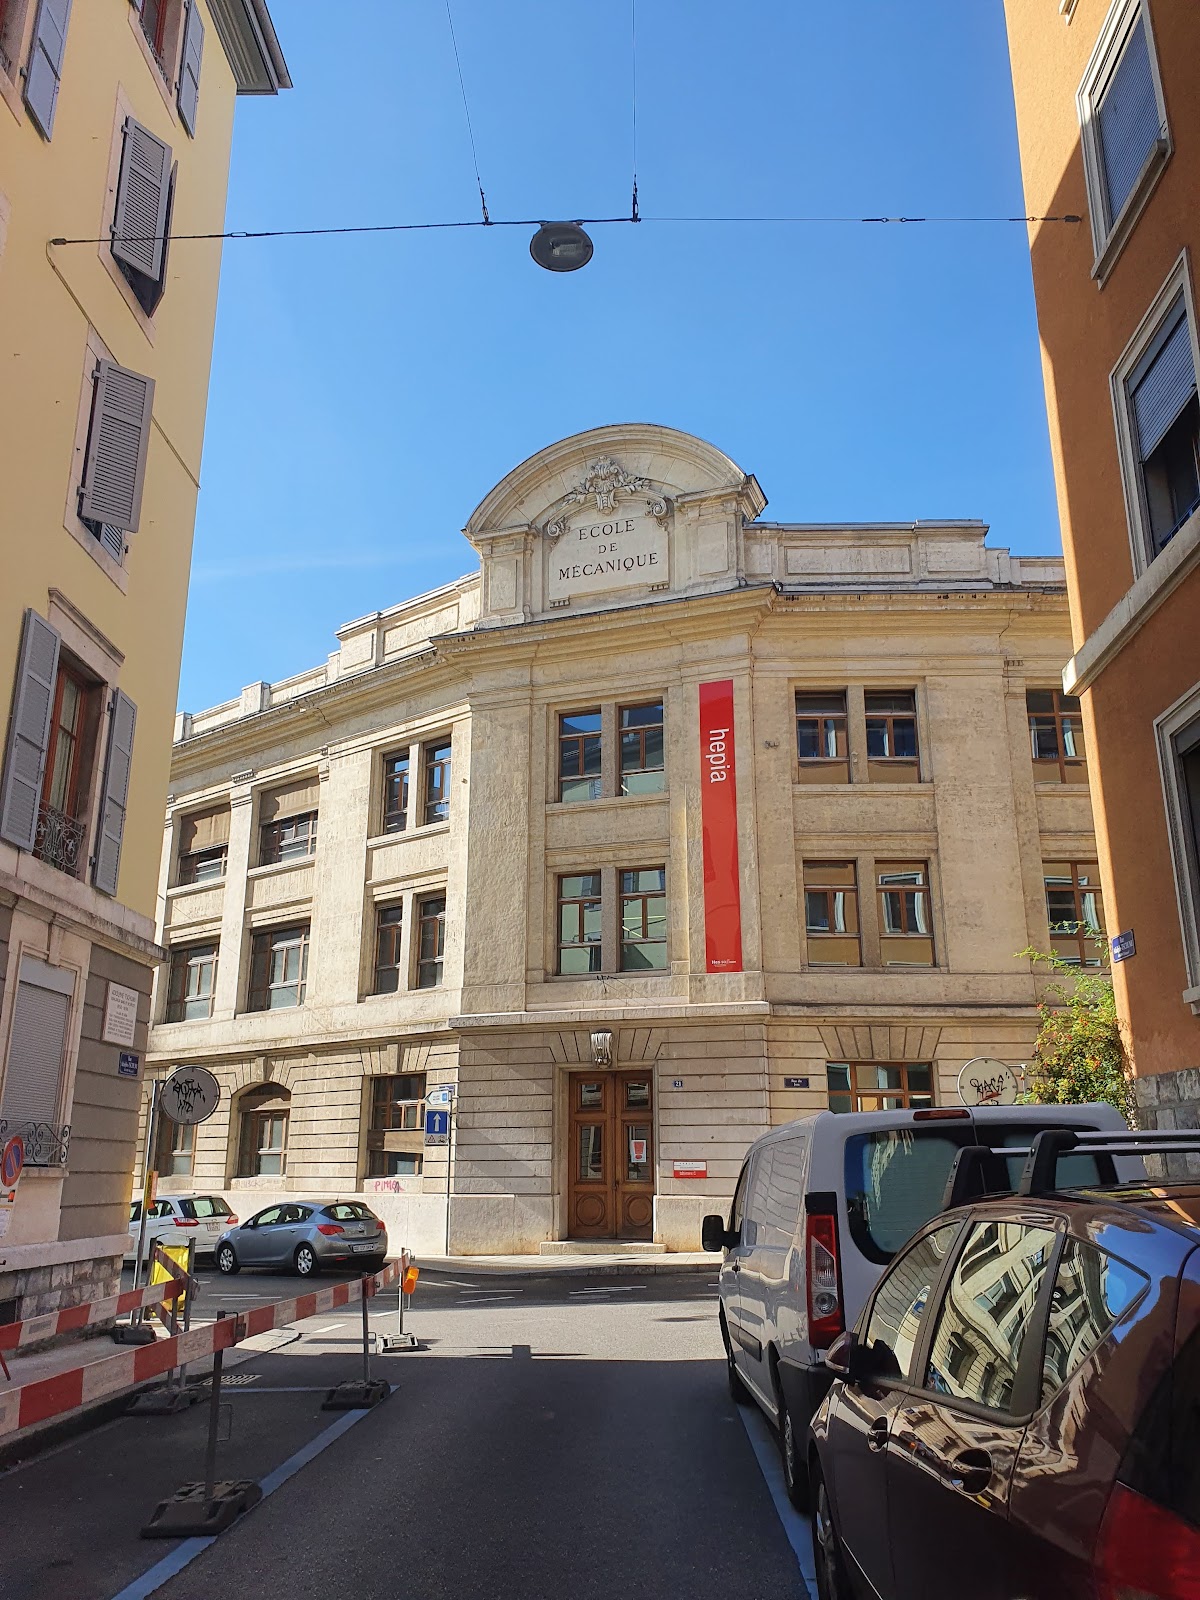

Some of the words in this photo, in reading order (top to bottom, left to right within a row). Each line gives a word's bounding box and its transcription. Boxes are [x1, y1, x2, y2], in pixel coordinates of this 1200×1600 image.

[579, 519, 635, 541] ECOLE
[598, 542, 619, 554] DE
[705, 728, 731, 784] hepia
